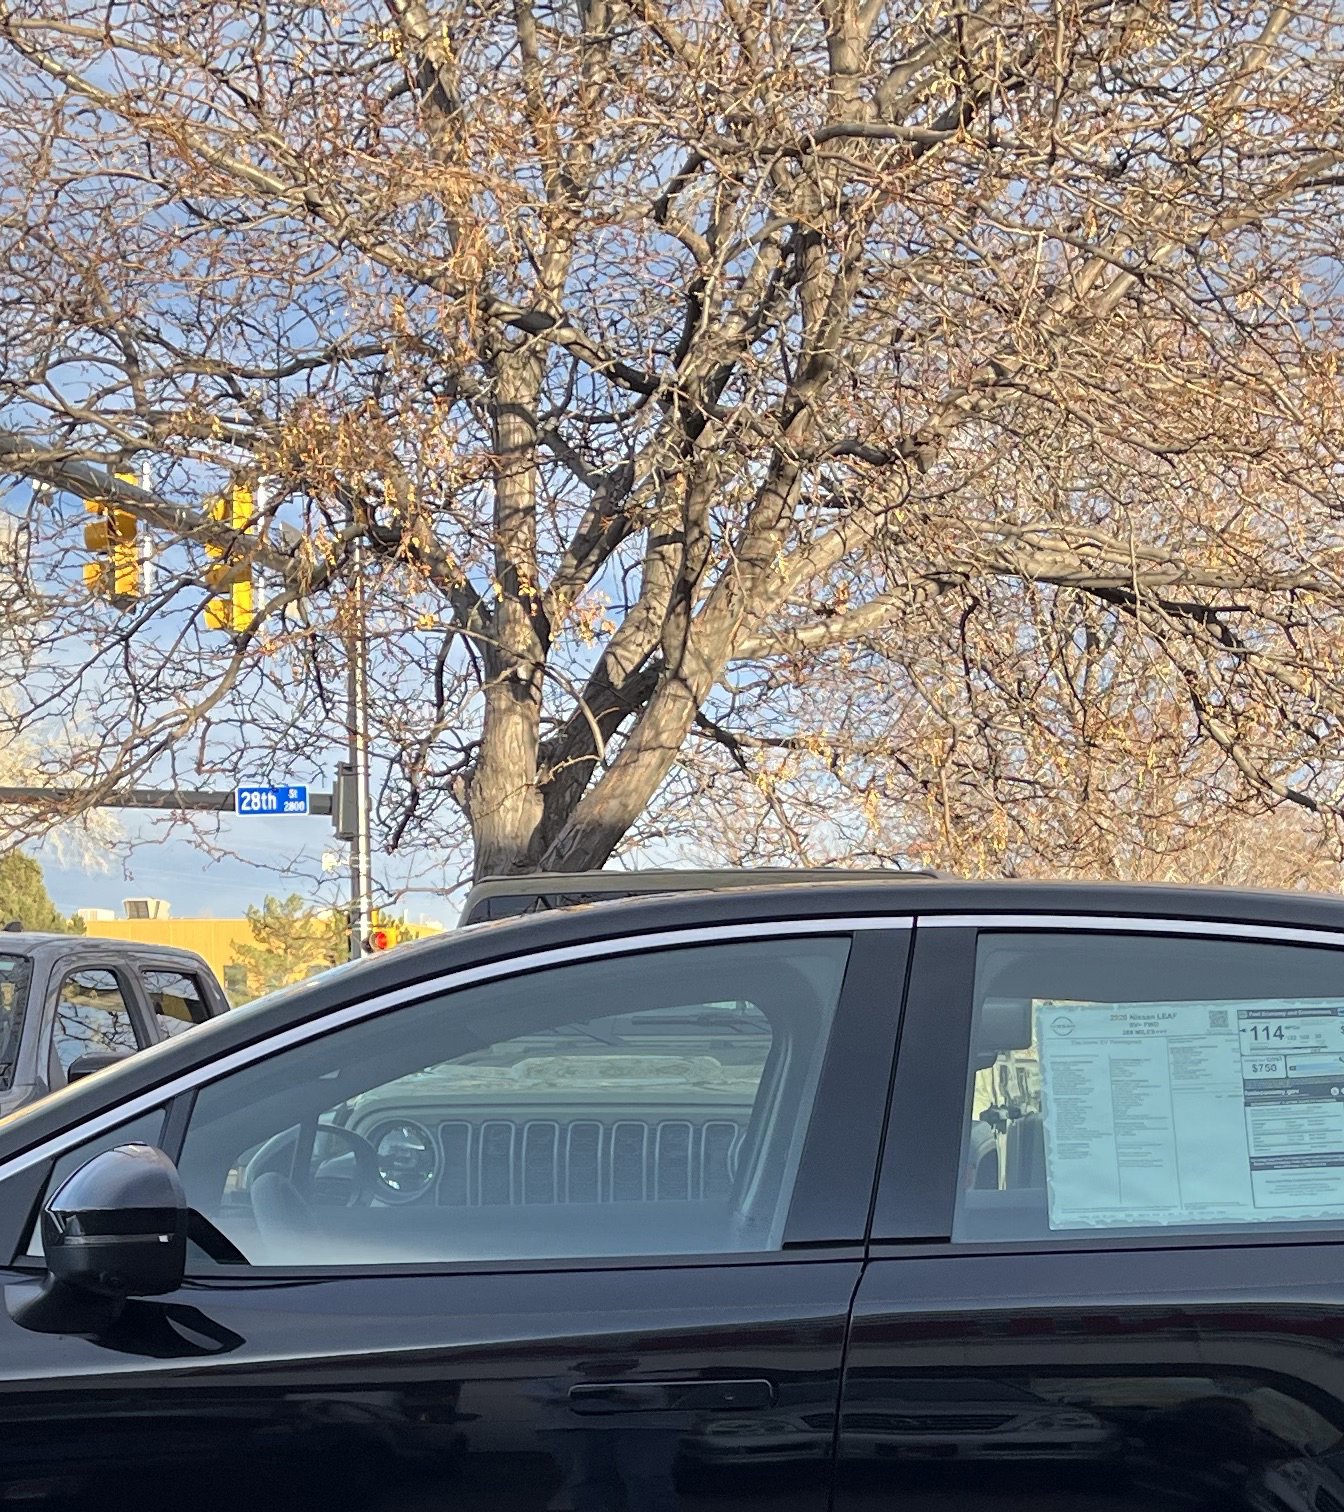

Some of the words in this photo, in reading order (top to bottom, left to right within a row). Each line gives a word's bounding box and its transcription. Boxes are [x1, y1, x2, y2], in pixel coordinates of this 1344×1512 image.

[241, 791, 277, 811] 28th
[288, 788, 298, 799] St
[1250, 1025, 1284, 1040] 114
[1252, 1063, 1277, 1073] $750
